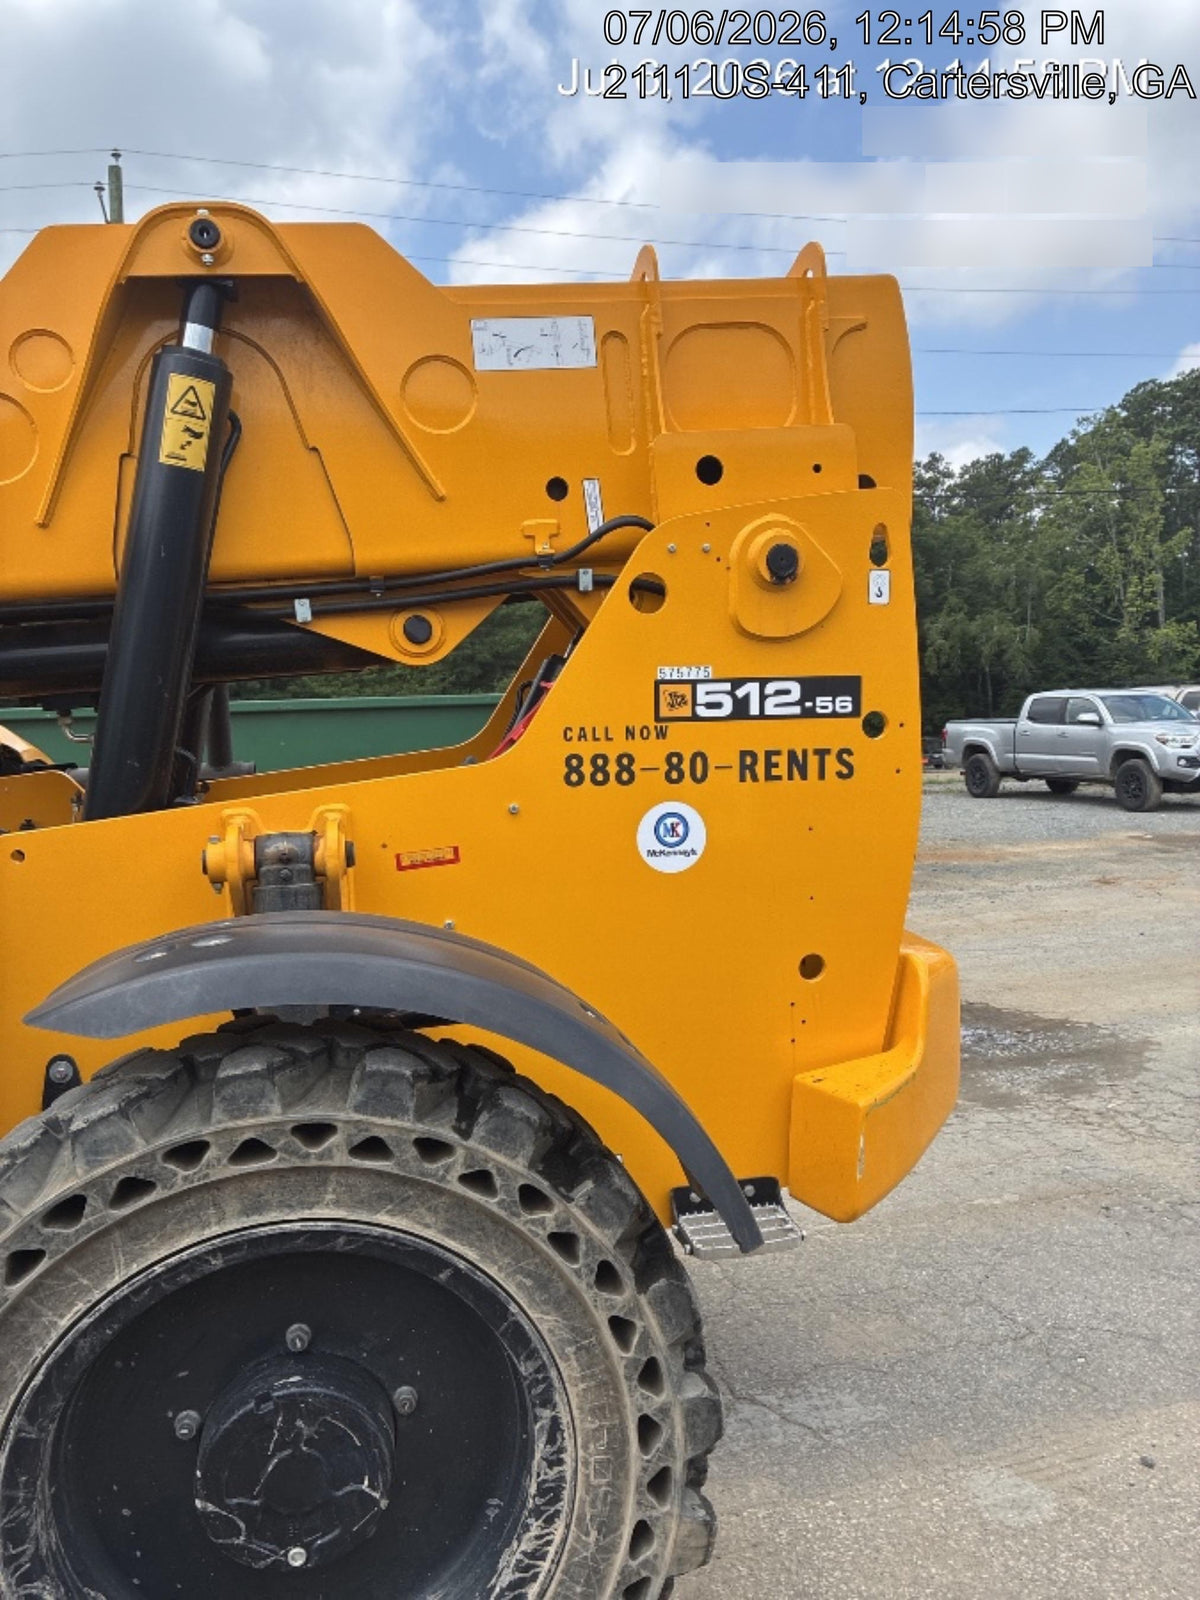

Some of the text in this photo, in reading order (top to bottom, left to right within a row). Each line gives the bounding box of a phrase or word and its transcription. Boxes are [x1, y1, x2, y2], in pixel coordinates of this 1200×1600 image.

[694, 681, 853, 718] 512-56
[563, 725, 669, 742] CALL NOW
[564, 748, 855, 787] 888-80-RENTS
